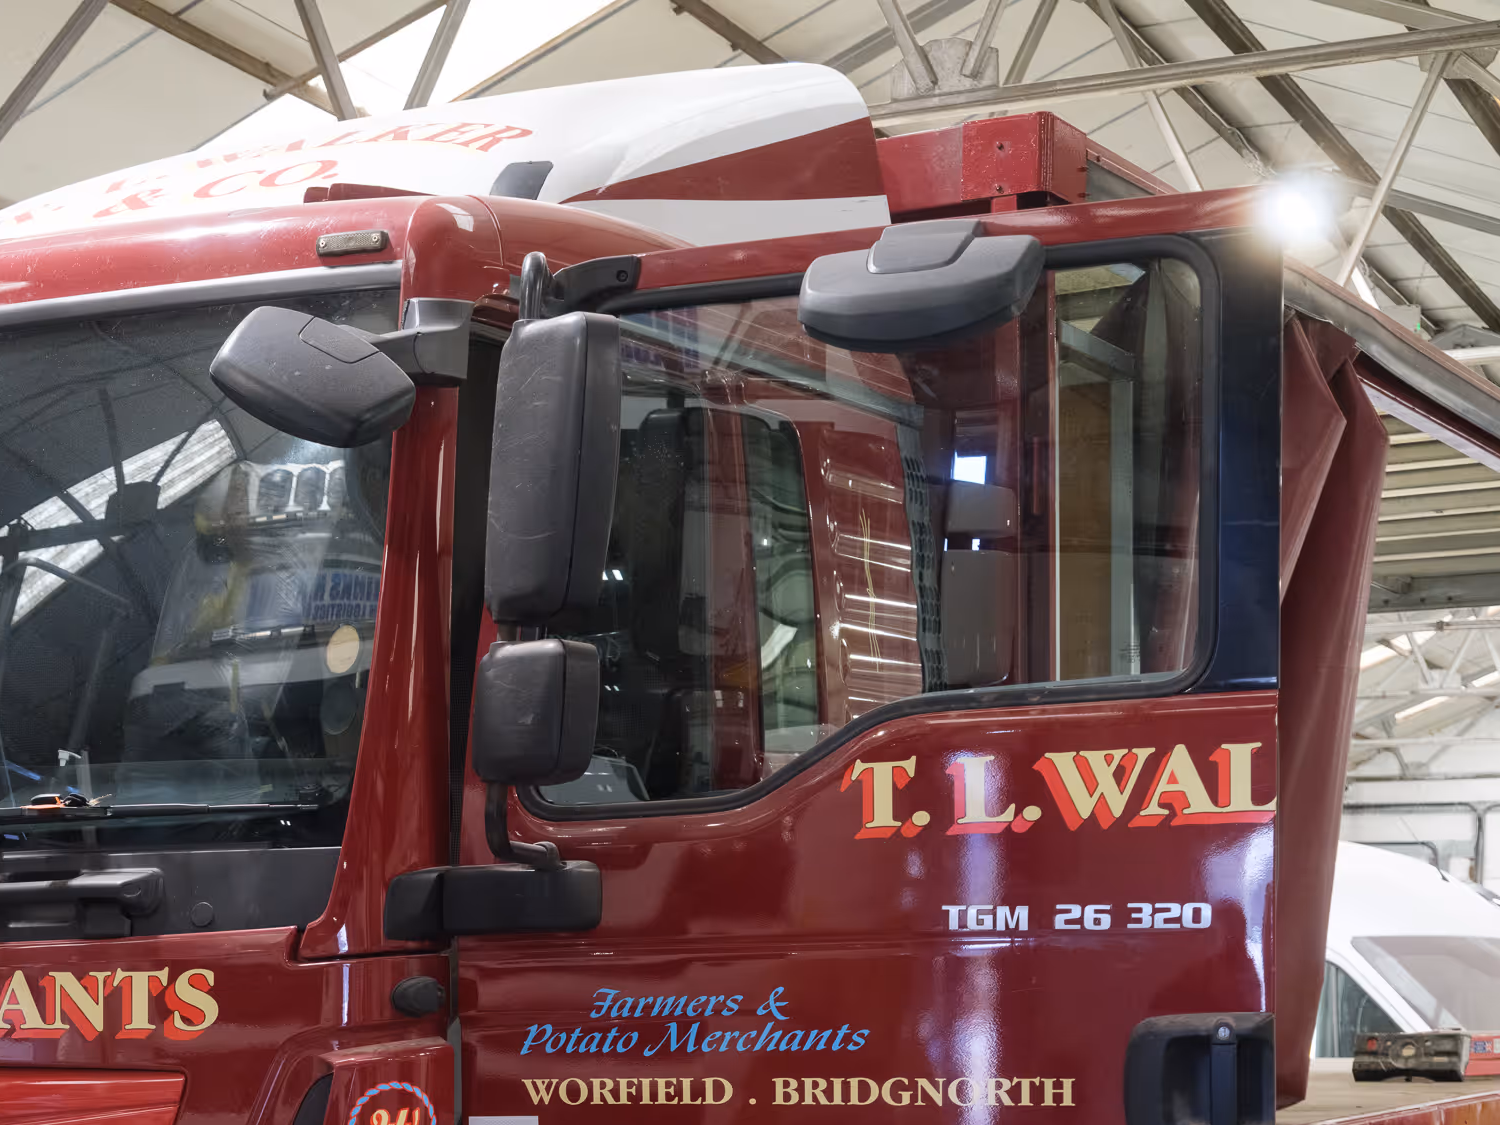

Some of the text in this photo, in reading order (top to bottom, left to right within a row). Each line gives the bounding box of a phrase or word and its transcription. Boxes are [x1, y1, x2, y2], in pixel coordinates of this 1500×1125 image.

[942, 902, 1213, 931] TGM 26 320
[590, 986, 790, 1020] Farmers &
[520, 1021, 871, 1057] Potato Merchants
[521, 1076, 734, 1106] WORFIELD
[772, 1075, 1076, 1108] BRIDGNORTH
